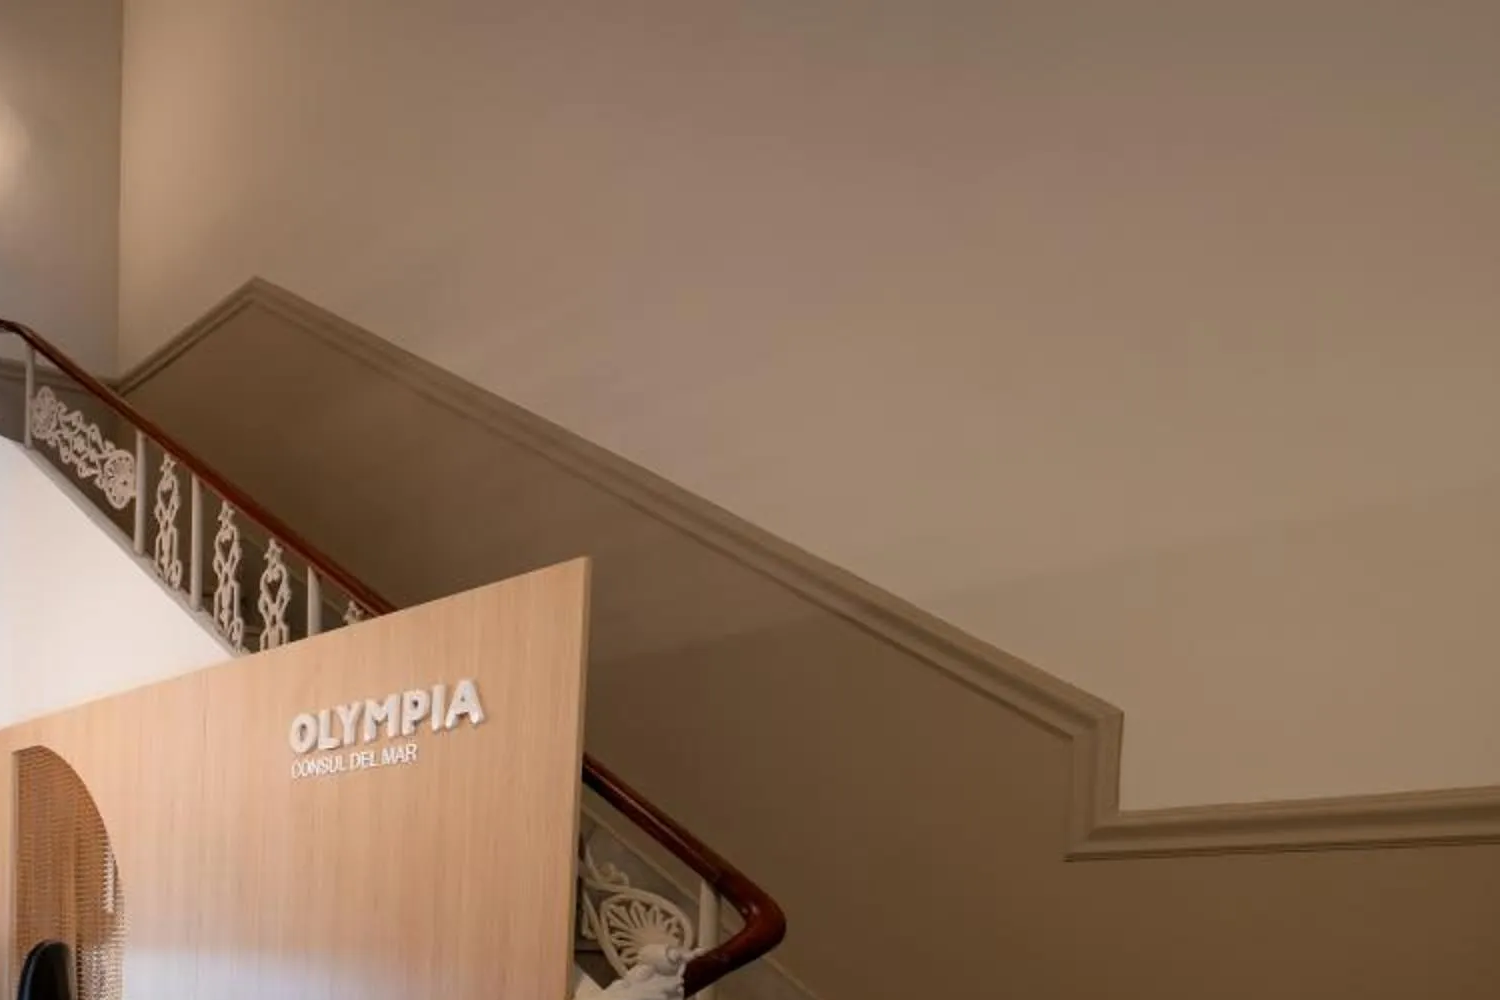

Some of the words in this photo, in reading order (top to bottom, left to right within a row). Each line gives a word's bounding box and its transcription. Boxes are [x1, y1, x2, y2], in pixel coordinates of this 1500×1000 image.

[289, 679, 484, 754] OLYMPIA
[291, 755, 348, 778] CONSUL
[351, 751, 379, 768] DEL
[381, 743, 418, 764] MAR
